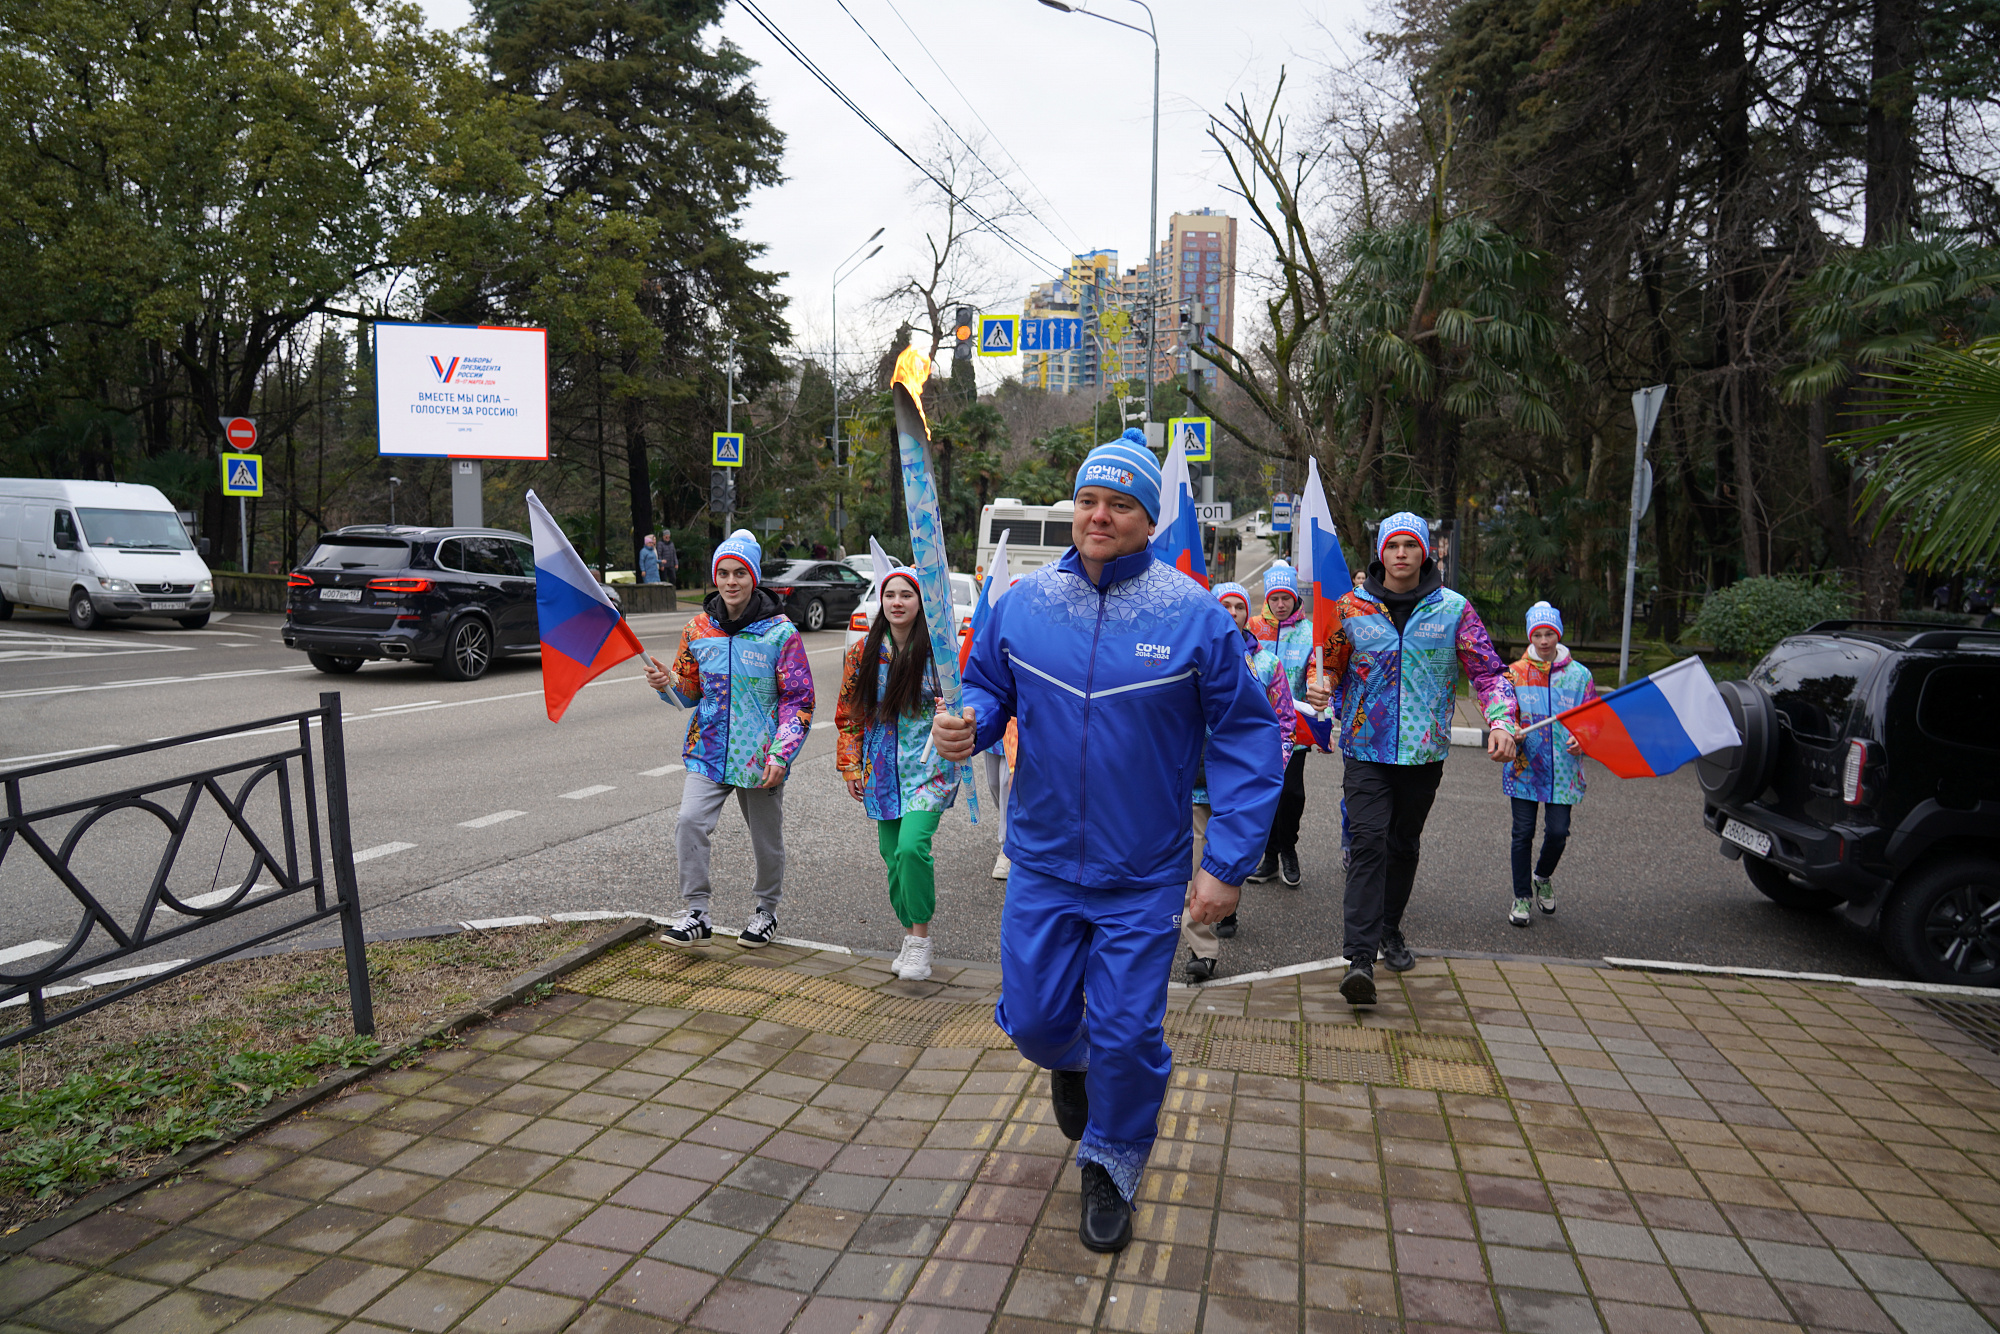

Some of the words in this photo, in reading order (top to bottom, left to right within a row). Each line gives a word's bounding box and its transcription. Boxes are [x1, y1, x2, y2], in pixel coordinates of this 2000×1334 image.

[418, 391, 455, 402] ВМЕСТЕ
[457, 393, 474, 403] МЫ
[476, 393, 501, 404] СИЛА
[410, 404, 460, 415] ГОЛОСУЕМ
[462, 406, 473, 416] ЗА
[475, 406, 518, 417] РОССИЮ!
[1087, 465, 1122, 477] СОЧИ
[1085, 473, 1119, 483] 2014-2024
[1195, 506, 1223, 519] ТОП
[1266, 576, 1291, 586] СОЧИ
[1418, 622, 1445, 633] СОЧИ
[1413, 631, 1447, 639] 2014-2024
[1136, 643, 1170, 654] СОЧИ
[742, 649, 767, 662] СОЧИ
[1135, 651, 1169, 659] 2014-2024
